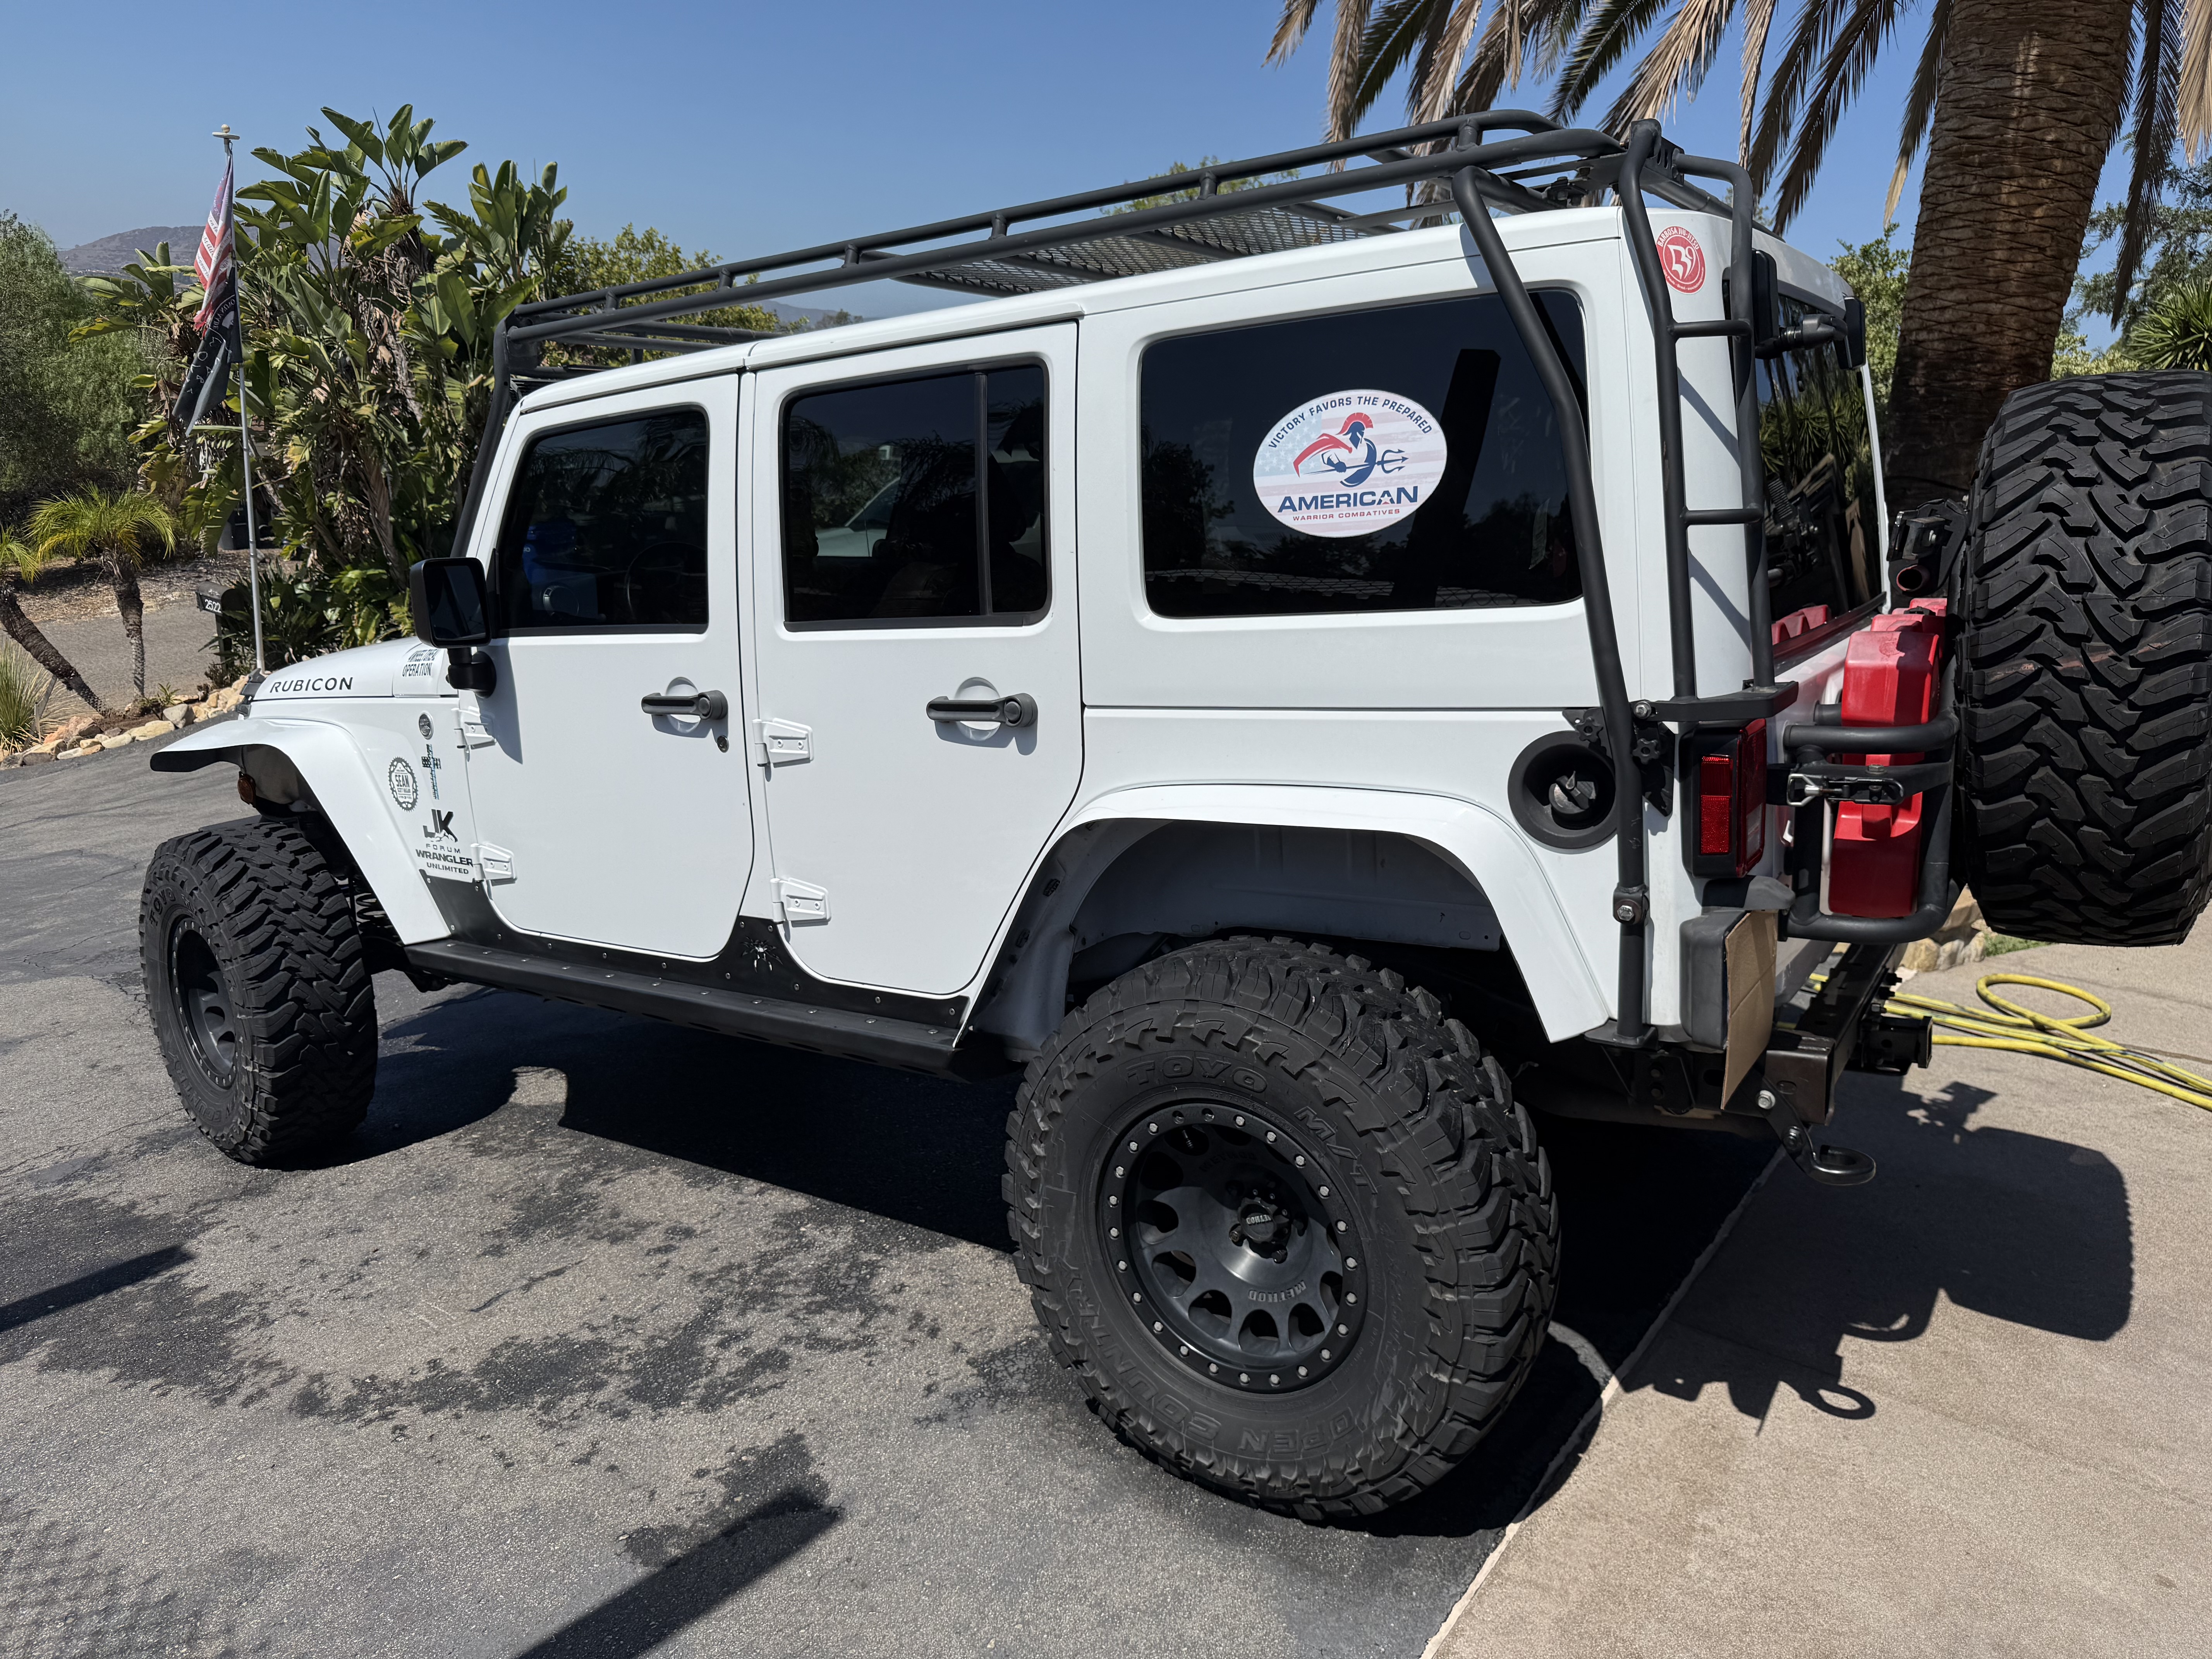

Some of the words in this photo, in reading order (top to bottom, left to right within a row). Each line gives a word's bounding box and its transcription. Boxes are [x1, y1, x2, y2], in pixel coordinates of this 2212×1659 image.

[1657, 227, 1678, 247] BARBOSA
[1678, 227, 1700, 250] JIU-JITSU
[1268, 412, 1306, 448] VICTORY
[1309, 397, 1352, 416] FAVORS
[1357, 396, 1379, 405] THE
[1382, 399, 1432, 434] PREPARED
[1278, 486, 1418, 513] AMERICAN
[1293, 513, 1334, 521] WARRIOR
[1338, 509, 1400, 518] COMBATIVES
[204, 599, 222, 613] 2522
[402, 662, 433, 677] OPERATION
[270, 677, 353, 693] RUBICON
[395, 775, 410, 788] SEAN
[422, 809, 459, 843] JK
[416, 849, 473, 867] WRANGLER
[426, 843, 461, 854] FORUM
[426, 862, 469, 874] UNLIMITED
[149, 887, 177, 927] TOYO
[1126, 1056, 1268, 1093] TOYO
[1247, 1279, 1307, 1303] METHOD
[1238, 1407, 1355, 1453] OPEN
